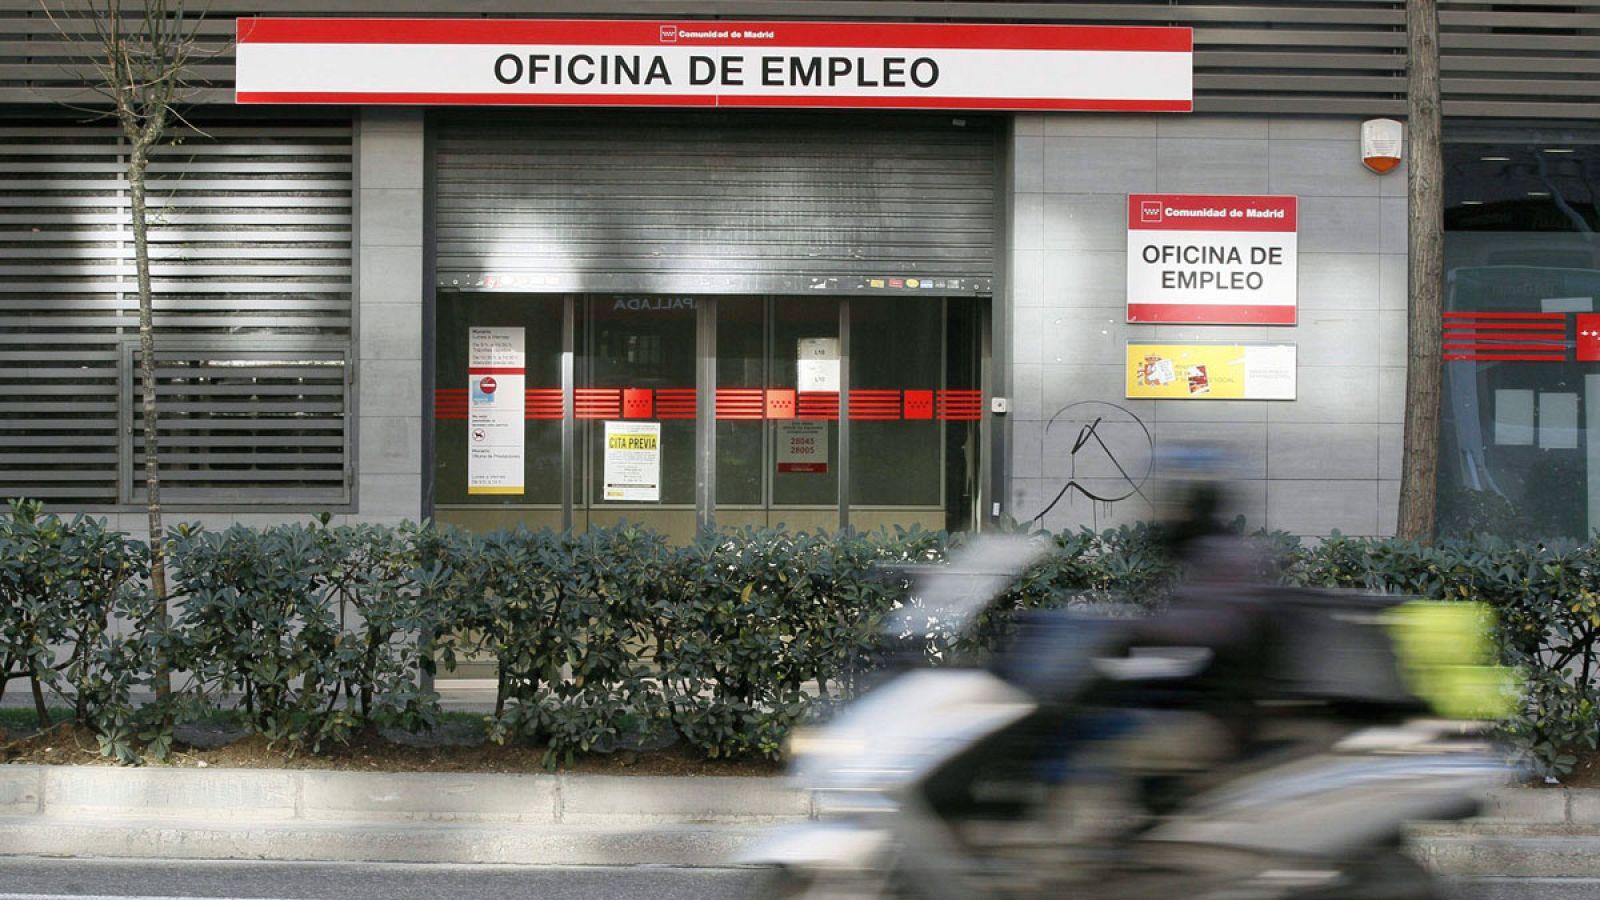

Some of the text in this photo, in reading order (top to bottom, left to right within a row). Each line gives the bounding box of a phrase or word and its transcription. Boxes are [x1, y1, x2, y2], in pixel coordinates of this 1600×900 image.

[679, 30, 775, 39] Comunidad de Madrid
[493, 53, 940, 89] OFICINA DE EMPLEO
[1164, 206, 1285, 219] Comunidad de Madrid
[1142, 244, 1283, 265] OFICINA DE
[1161, 270, 1264, 290] EMPLEO
[609, 437, 657, 450] CITA PREVIA
[790, 437, 815, 445] 28045
[790, 446, 815, 454] 28005
